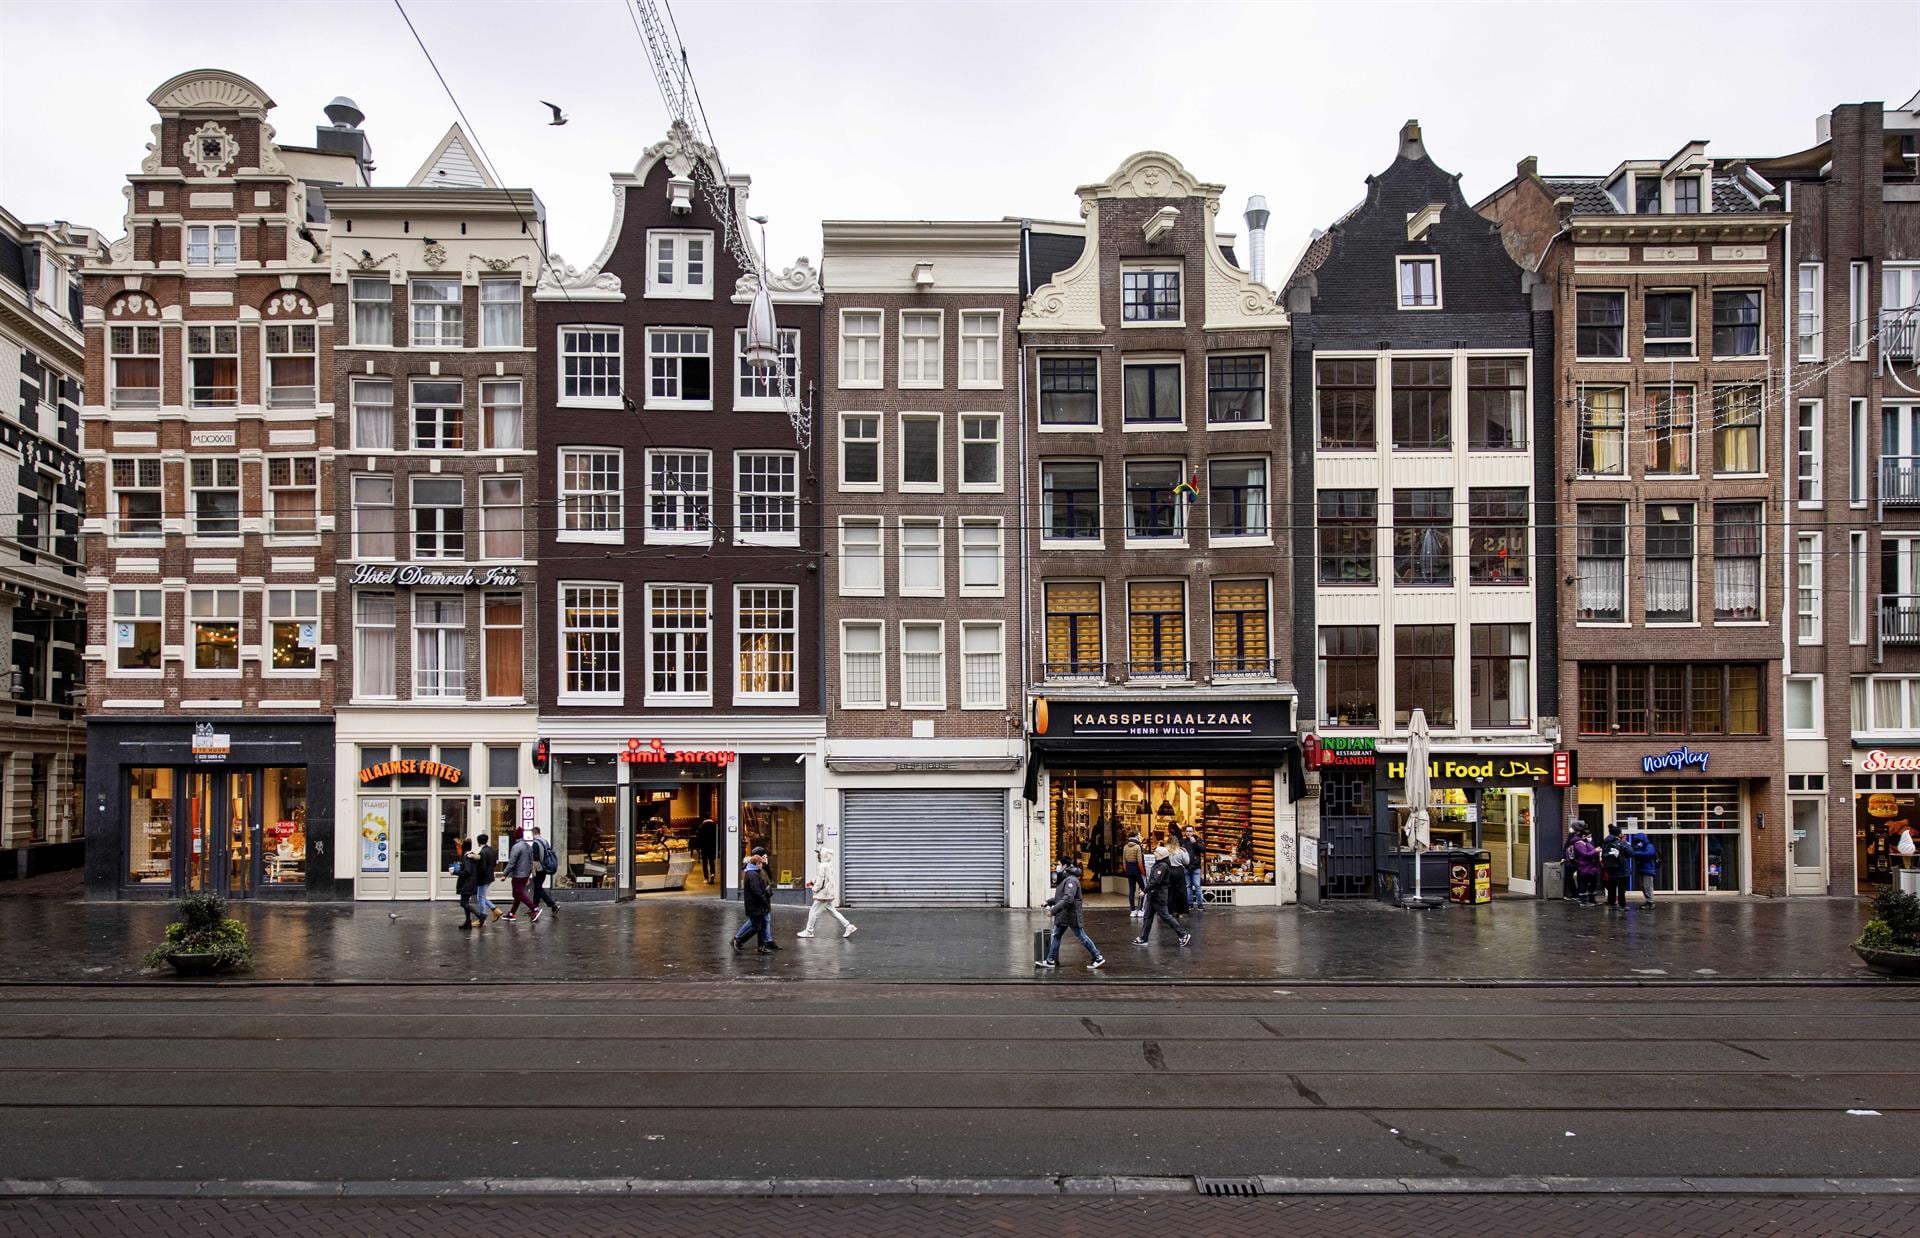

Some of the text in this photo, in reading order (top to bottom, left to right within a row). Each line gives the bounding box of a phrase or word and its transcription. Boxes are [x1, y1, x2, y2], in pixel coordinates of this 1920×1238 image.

[398, 565, 474, 585] Damrak
[476, 566, 518, 586] Inn
[1073, 713, 1252, 725] KAASSPECIAALZAAK
[1163, 727, 1195, 735] WILLIG
[620, 738, 667, 763] simit
[1642, 746, 1710, 773] novoplay
[1335, 757, 1375, 765] GANDHI
[1446, 761, 1494, 779] Food
[358, 760, 463, 784] VLAAMSE FRITES
[594, 796, 617, 804] PASTRY
